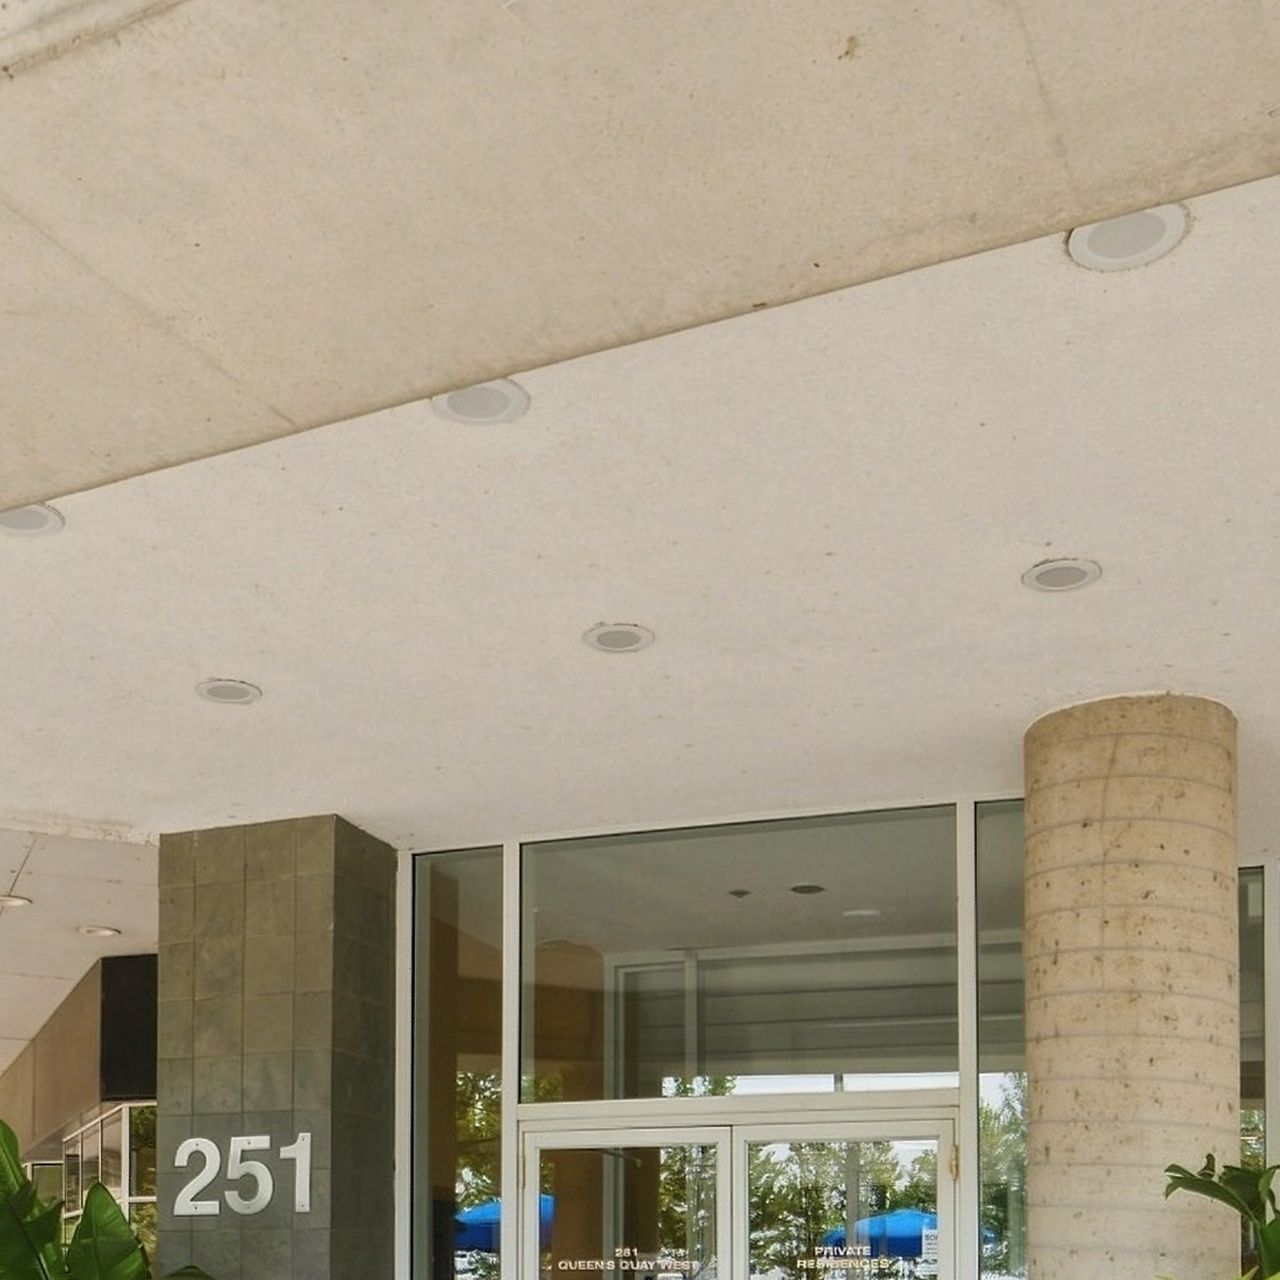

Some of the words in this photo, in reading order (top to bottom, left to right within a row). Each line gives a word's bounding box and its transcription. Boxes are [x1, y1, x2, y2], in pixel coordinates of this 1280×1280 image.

[173, 1132, 311, 1216] 251
[815, 1246, 871, 1256] PRIVATE
[620, 1260, 655, 1270] QUAY
[660, 1260, 699, 1270] WEST
